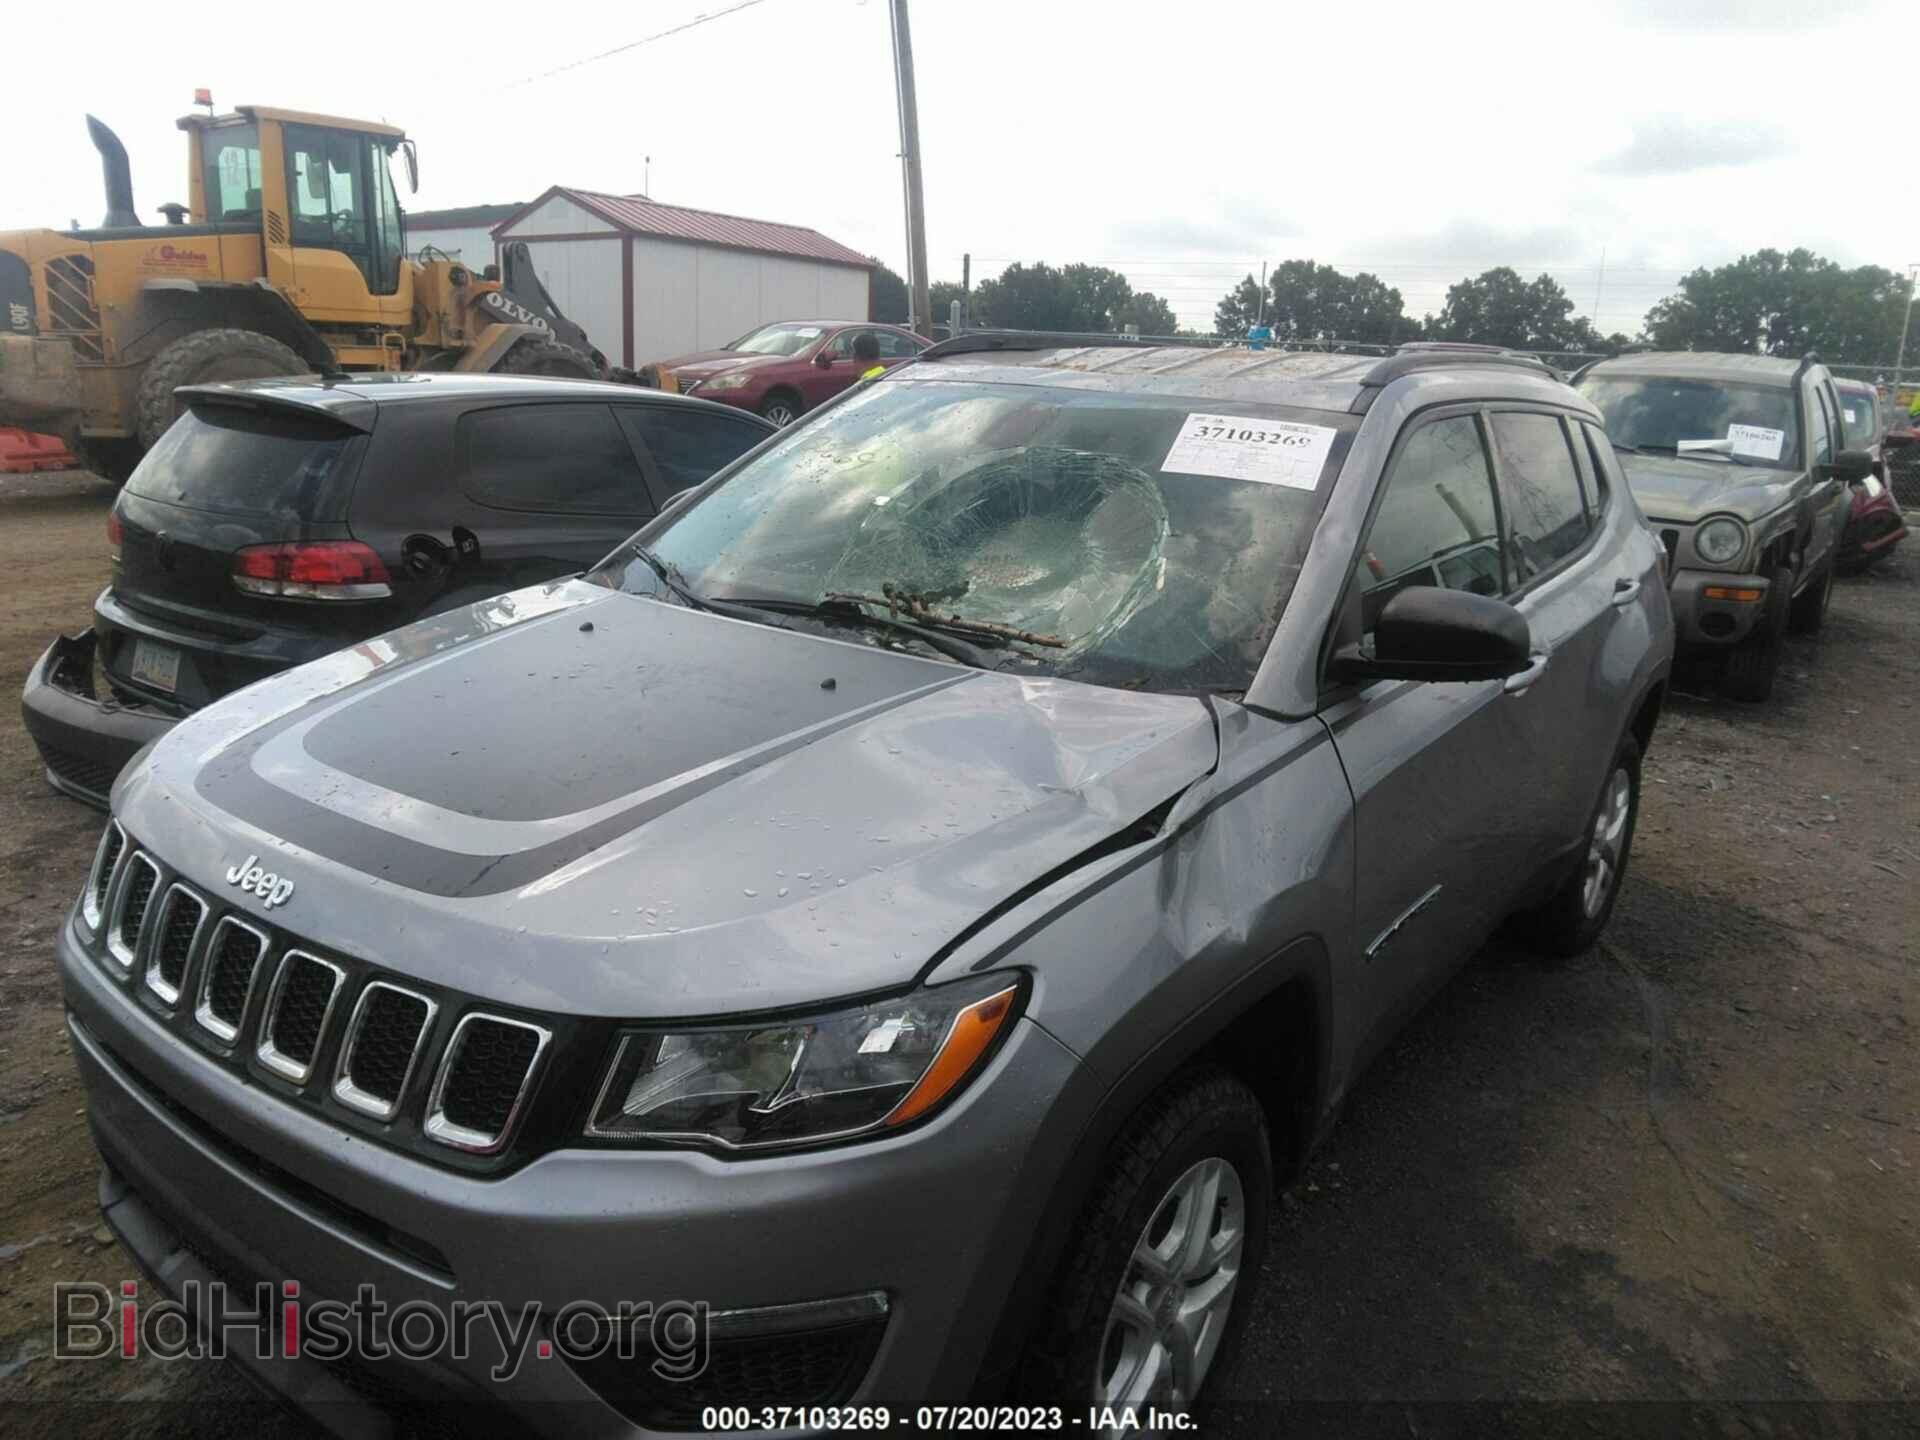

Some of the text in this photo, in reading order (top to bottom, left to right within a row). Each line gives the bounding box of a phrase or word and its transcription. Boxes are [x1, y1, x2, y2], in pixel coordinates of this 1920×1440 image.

[9, 302, 29, 330] L90F
[1194, 426, 1311, 448] 37103269
[226, 855, 295, 910] Jeep
